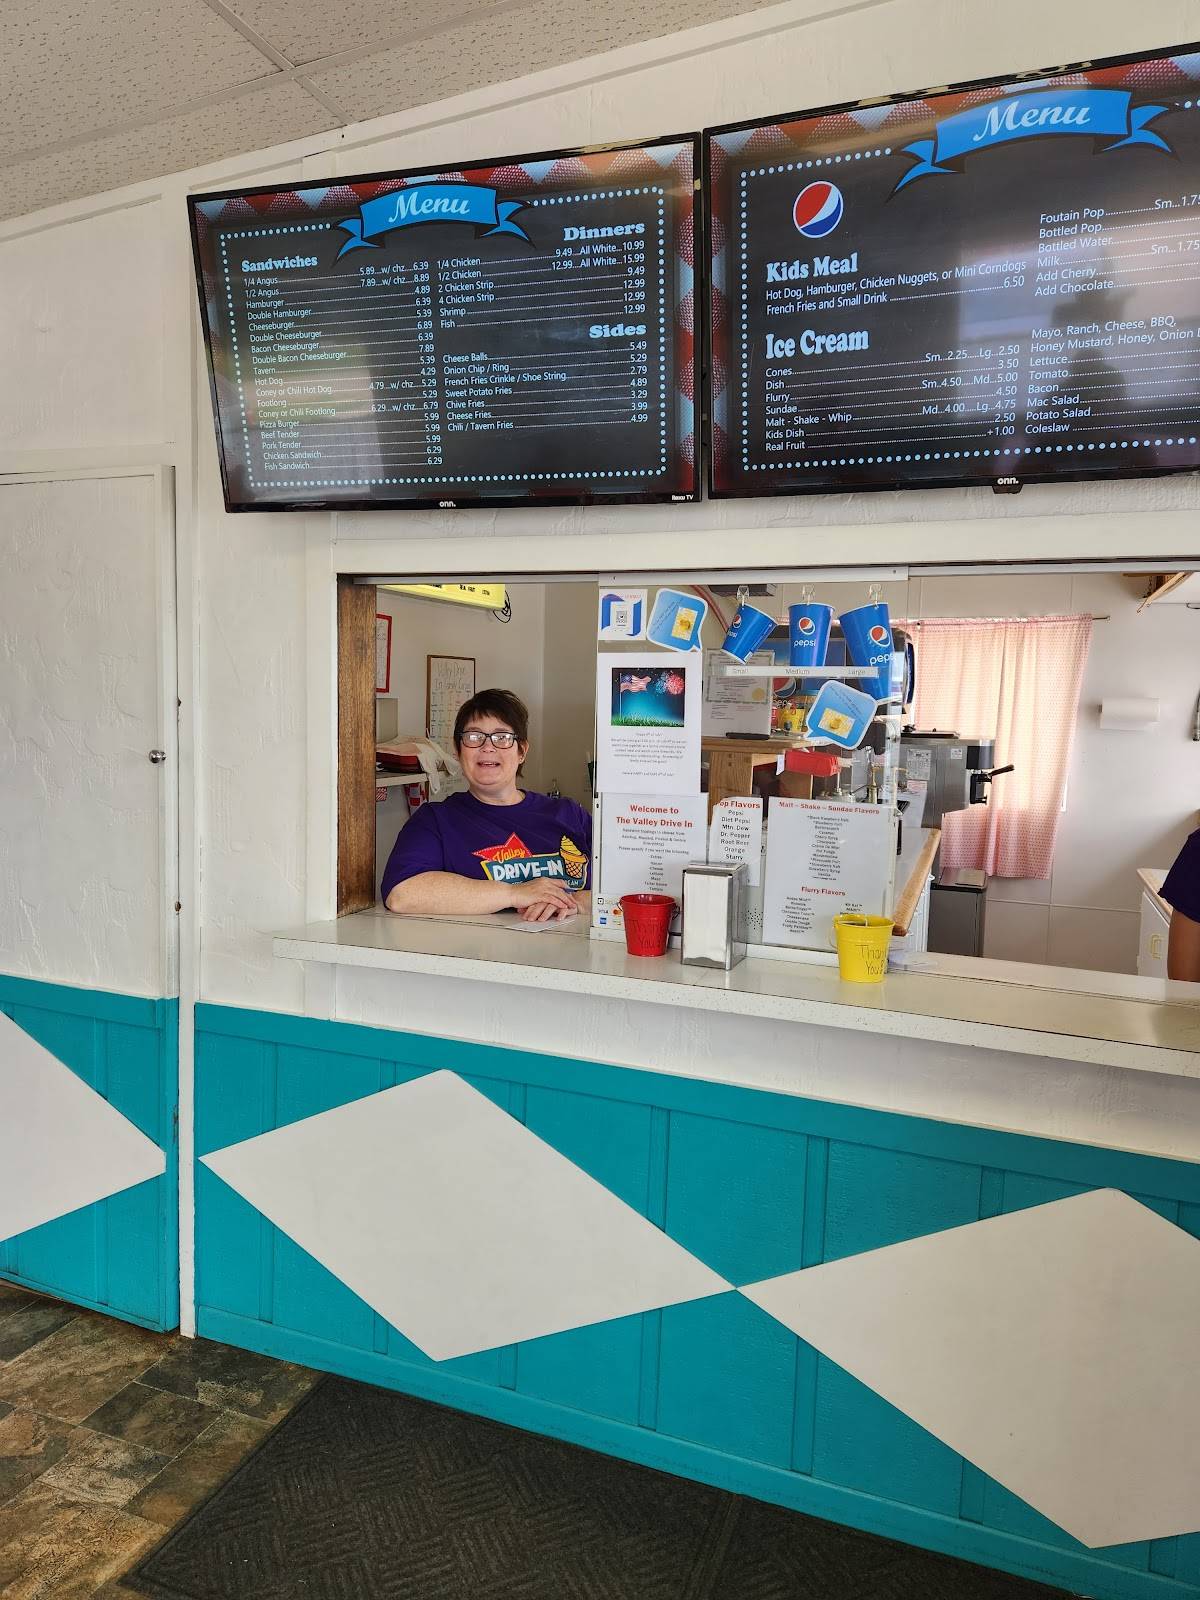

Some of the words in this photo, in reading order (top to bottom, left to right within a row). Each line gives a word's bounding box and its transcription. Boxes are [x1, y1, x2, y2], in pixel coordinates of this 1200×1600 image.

[973, 101, 1090, 141] Menu
[389, 192, 470, 223] Menu
[1040, 210, 1079, 223] Foutain
[1083, 208, 1105, 218] Pop
[564, 223, 645, 241] Dinners
[1039, 225, 1077, 238] Bottled
[1081, 223, 1102, 233] Pop
[1039, 240, 1076, 253] Bottled
[1080, 237, 1112, 247] Water
[241, 256, 318, 272] Sandwiches
[437, 261, 449, 269] 1/4
[451, 257, 481, 267] Chicken
[766, 261, 809, 283] Kids
[813, 252, 858, 277] Meal
[1037, 256, 1060, 268] Milk
[438, 272, 450, 281] 1/2
[452, 270, 481, 280] Chicken
[445, 283, 474, 292] Chicken
[476, 281, 494, 291] Strip
[628, 267, 645, 275] 9.49
[766, 290, 782, 300] Hot
[784, 287, 803, 298] Dog,
[806, 282, 857, 295] Hamburger,
[860, 277, 895, 290] Chicken
[898, 271, 939, 286] Nuggets,
[942, 271, 952, 279] or
[955, 264, 976, 278] Mini
[978, 260, 1026, 276] Corndogs
[1036, 271, 1057, 282] Add
[1061, 268, 1096, 279] Cherry
[446, 295, 475, 304] Chicken
[476, 293, 495, 303] Strip
[624, 279, 645, 288] 12.99
[767, 304, 794, 315] French
[797, 301, 816, 311] Fries
[818, 300, 835, 309] and
[837, 295, 861, 307] Small
[864, 293, 887, 304] Drink
[1004, 276, 1024, 288] 6.50
[1035, 286, 1056, 297] Add
[1060, 280, 1114, 293] Chocolate
[246, 300, 284, 310] Hamburger
[415, 286, 430, 294] 4.89
[440, 308, 466, 317] Shrimp
[624, 292, 645, 301] 12.99
[248, 312, 272, 320] Double
[273, 309, 311, 319] Hamburger
[416, 298, 431, 306] 6.39
[441, 320, 455, 328] Fish
[624, 305, 645, 313] 12.99
[249, 321, 294, 331] Cheeseburger
[416, 309, 432, 317] 5.39
[1032, 328, 1063, 340] Mayo,
[1067, 323, 1100, 335] Ranch,
[1105, 319, 1146, 331] Cheese,
[1151, 316, 1176, 327] BBQ,
[250, 334, 274, 342] Double
[276, 332, 322, 341] Cheeseburger
[417, 321, 432, 329] 6.89
[589, 324, 647, 339] Sides
[766, 333, 795, 359] Ice
[800, 329, 869, 355] Cream
[1031, 342, 1064, 353] Honey
[1068, 336, 1113, 349] Mustard,
[1118, 333, 1155, 344] Honey,
[1160, 329, 1193, 340] Onion
[443, 354, 469, 362] Cheese
[471, 353, 488, 361] Balls
[630, 341, 647, 350] 5.49
[444, 366, 466, 374] Onion
[468, 364, 485, 373] Chip
[492, 364, 509, 373] Ring
[630, 354, 647, 362] 5.29
[1030, 356, 1067, 366] Lettuce
[445, 378, 469, 386] French
[490, 375, 515, 383] Crinkle
[523, 373, 541, 381] Shoe
[544, 372, 566, 382] String
[631, 366, 647, 374] 2.79
[766, 367, 792, 377] Cones
[766, 381, 785, 390] Dish
[998, 359, 1019, 369] 3.50
[1030, 369, 1068, 380] Tomato
[446, 390, 467, 398] Sweet
[469, 388, 493, 396] Potato
[630, 378, 647, 386] 4.89
[1028, 384, 1059, 393] Bacon
[766, 393, 790, 403] Flurry
[766, 405, 797, 414] Sundae
[996, 386, 1017, 396] 4.50
[1028, 397, 1048, 407] Mac
[1052, 394, 1079, 405] Salad
[448, 423, 464, 431] Chili
[471, 422, 495, 430] Tavern
[497, 421, 513, 429] Fries
[631, 414, 648, 422] 4.99
[766, 417, 785, 427] Malt
[794, 414, 819, 425] Shake
[828, 413, 852, 424] Whip
[1026, 410, 1059, 421] Potato
[1063, 407, 1091, 418] Salad
[766, 430, 783, 439] Kids
[786, 428, 805, 437] Dish
[995, 413, 1015, 423] 2.50
[1025, 424, 1070, 434] Coleslaw
[766, 442, 783, 451] Real
[786, 440, 805, 450] Fruit
[987, 425, 1015, 436] +1.00
[291, 451, 321, 459] Sandwich
[427, 446, 441, 454] 6.29
[428, 457, 442, 465] 6.29
[630, 804, 667, 814] Welcome
[730, 800, 760, 809] Flavors
[633, 817, 657, 827] Valley
[661, 819, 683, 827] Drive
[493, 848, 525, 863] Valley
[492, 860, 564, 881] DRIVE-IN
